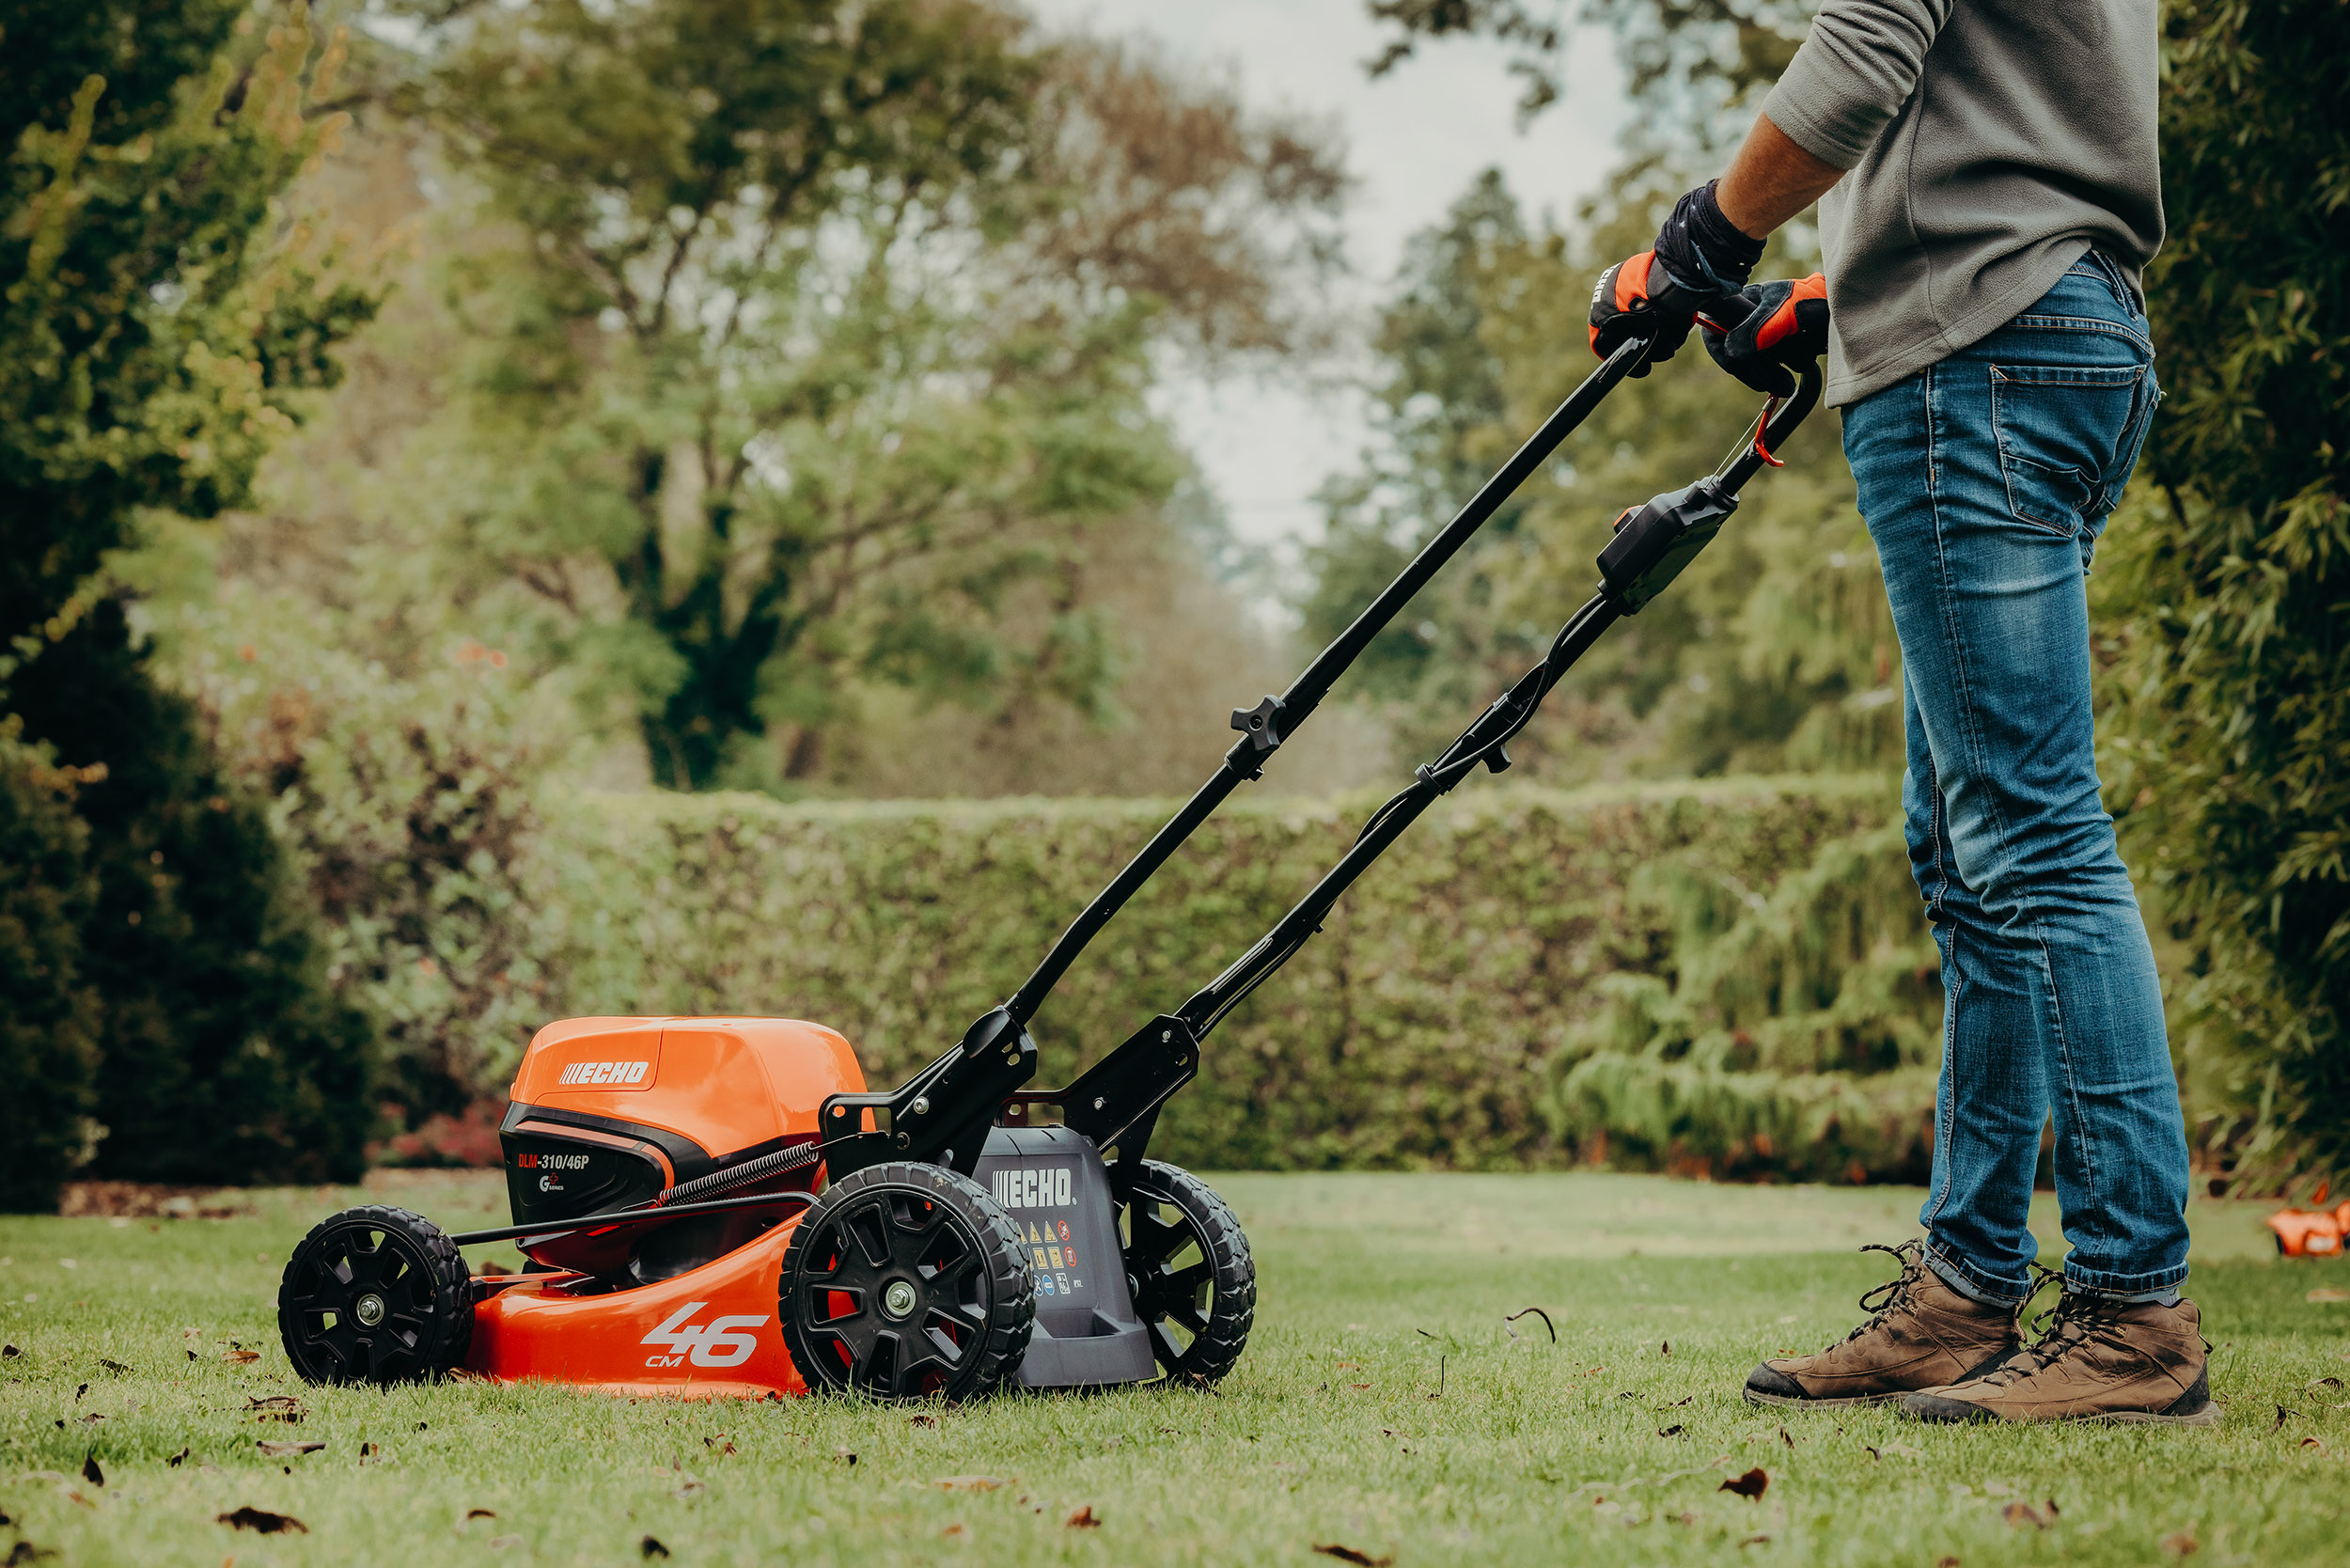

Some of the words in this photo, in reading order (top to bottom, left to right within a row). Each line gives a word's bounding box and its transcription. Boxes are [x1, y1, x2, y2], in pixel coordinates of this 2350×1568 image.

[576, 1061, 649, 1084] ECHO
[518, 1153, 589, 1169] DLM-310/46P
[1010, 1168, 1072, 1208] ECHO
[640, 1301, 771, 1367] 46
[645, 1356, 684, 1367] CM
